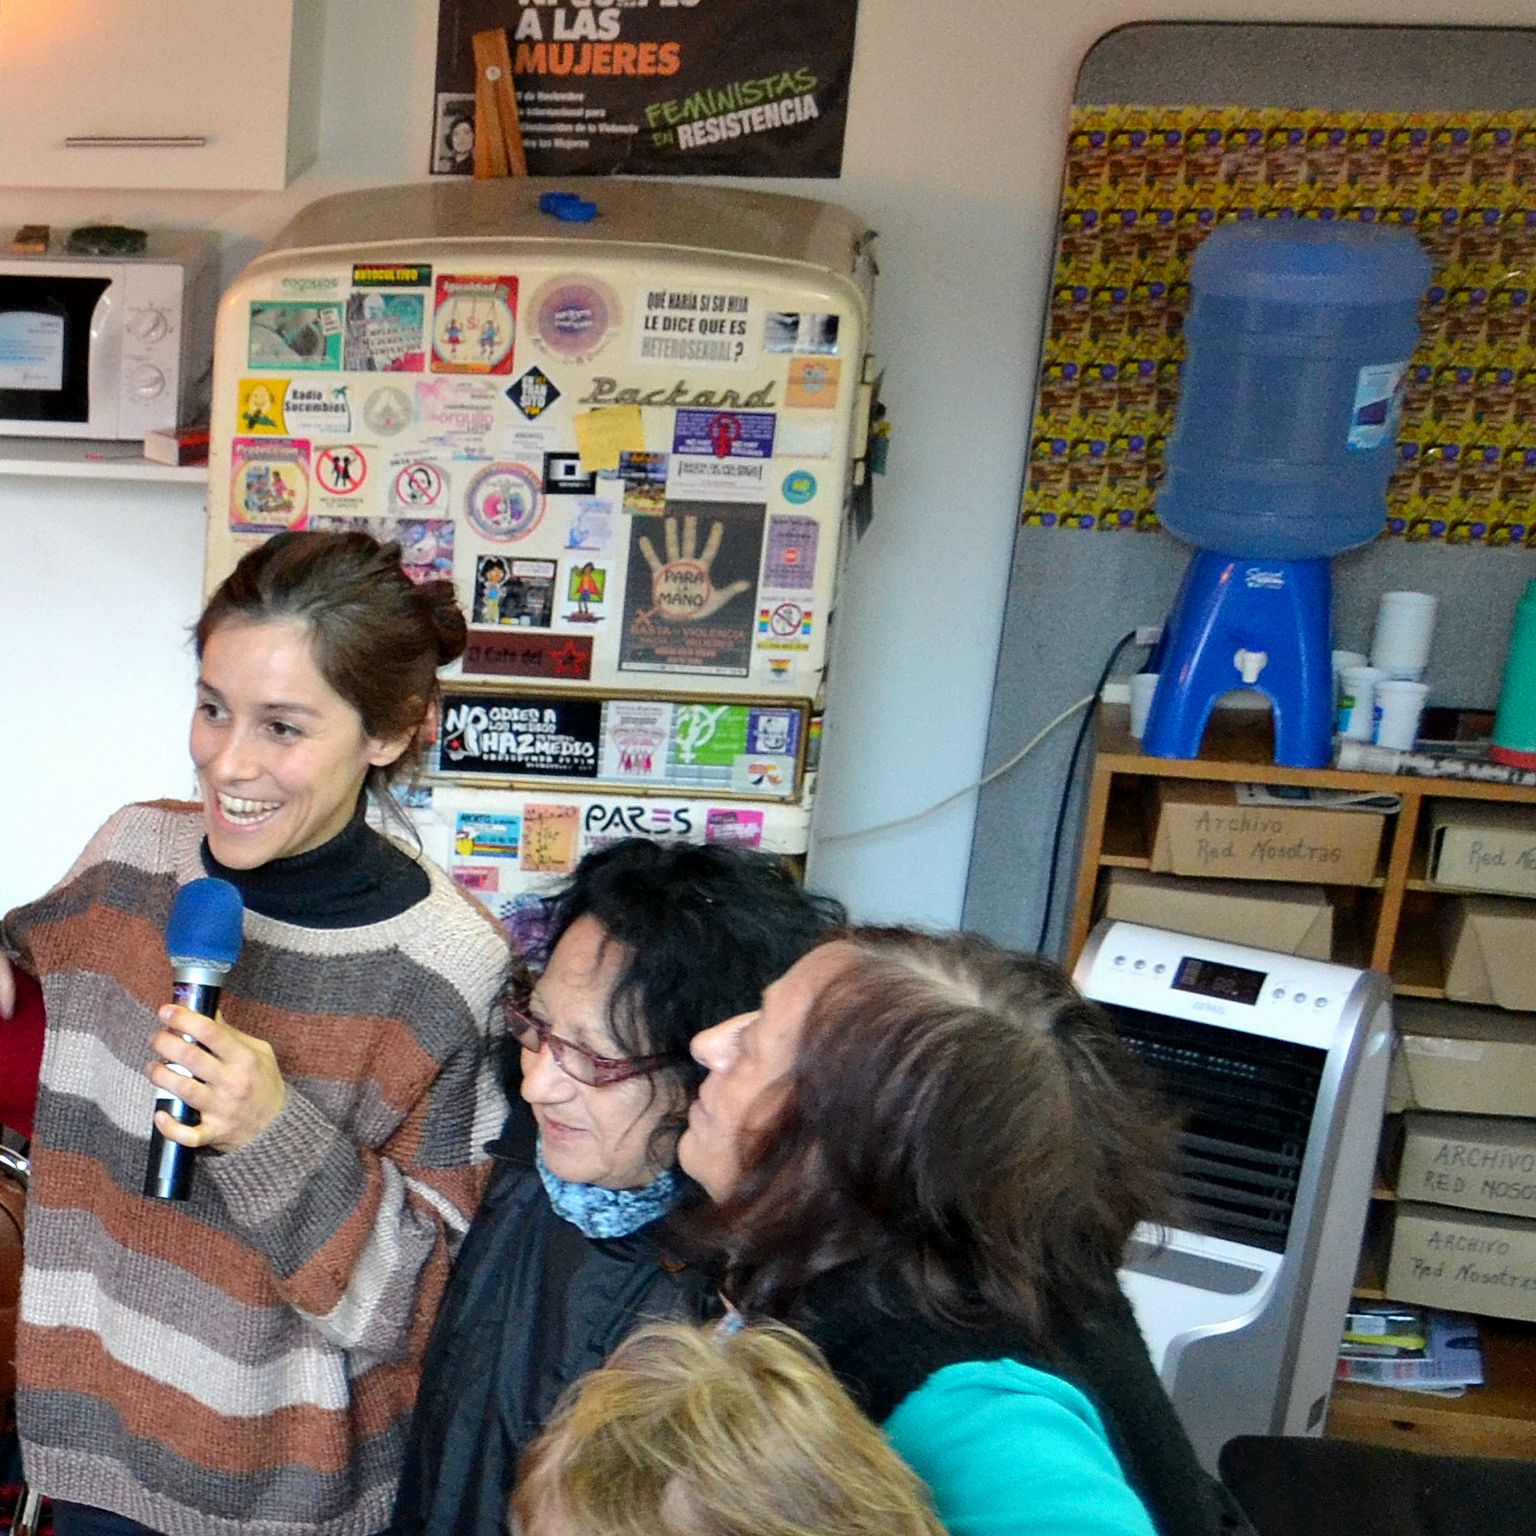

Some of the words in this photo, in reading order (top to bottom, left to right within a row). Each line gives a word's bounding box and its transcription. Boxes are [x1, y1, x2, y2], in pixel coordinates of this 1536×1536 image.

[514, 8, 543, 41] A
[553, 8, 621, 41] LAS
[514, 42, 680, 76] MUJERES
[644, 66, 818, 128] FEMINISTAS
[653, 130, 675, 148] EN
[678, 94, 820, 150] RESISTENCIA
[699, 294, 710, 312] SI
[712, 295, 726, 312] SU
[644, 315, 659, 331] LE
[662, 316, 696, 333] DICE
[699, 318, 725, 335] QUE
[730, 319, 747, 336] ES
[292, 388, 323, 401] Radio
[579, 376, 776, 409] Packard
[664, 569, 704, 584] PARA
[659, 592, 703, 607] MANO
[535, 740, 595, 758] MEDIO
[1194, 810, 1283, 834] Archivo
[1196, 839, 1234, 864] Red
[1249, 840, 1343, 865] Nosotras
[1469, 840, 1508, 873] Red
[1424, 1170, 1466, 1194] RED
[1409, 1255, 1446, 1280] Red
